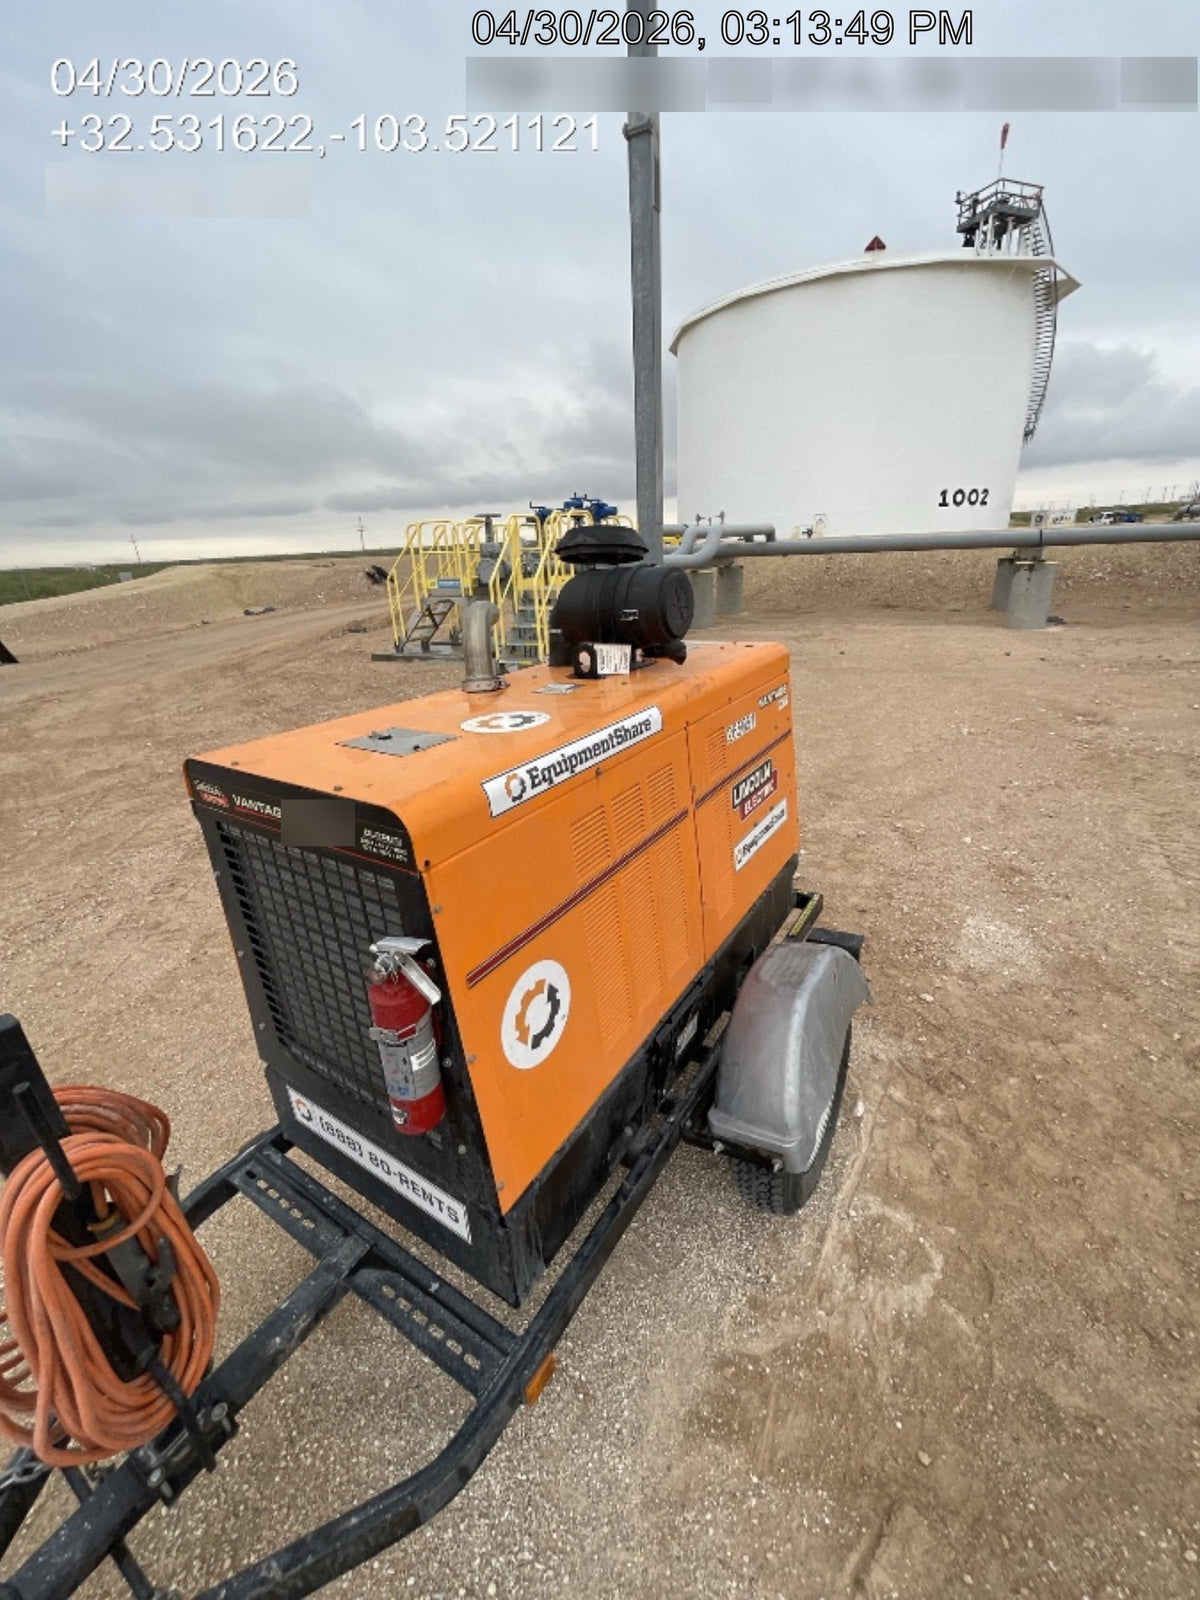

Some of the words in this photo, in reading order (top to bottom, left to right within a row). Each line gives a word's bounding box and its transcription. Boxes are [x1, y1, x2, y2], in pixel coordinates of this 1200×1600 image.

[937, 488, 990, 508] 1002
[525, 717, 652, 791] EquipmentShare
[232, 794, 282, 819] VANTAG
